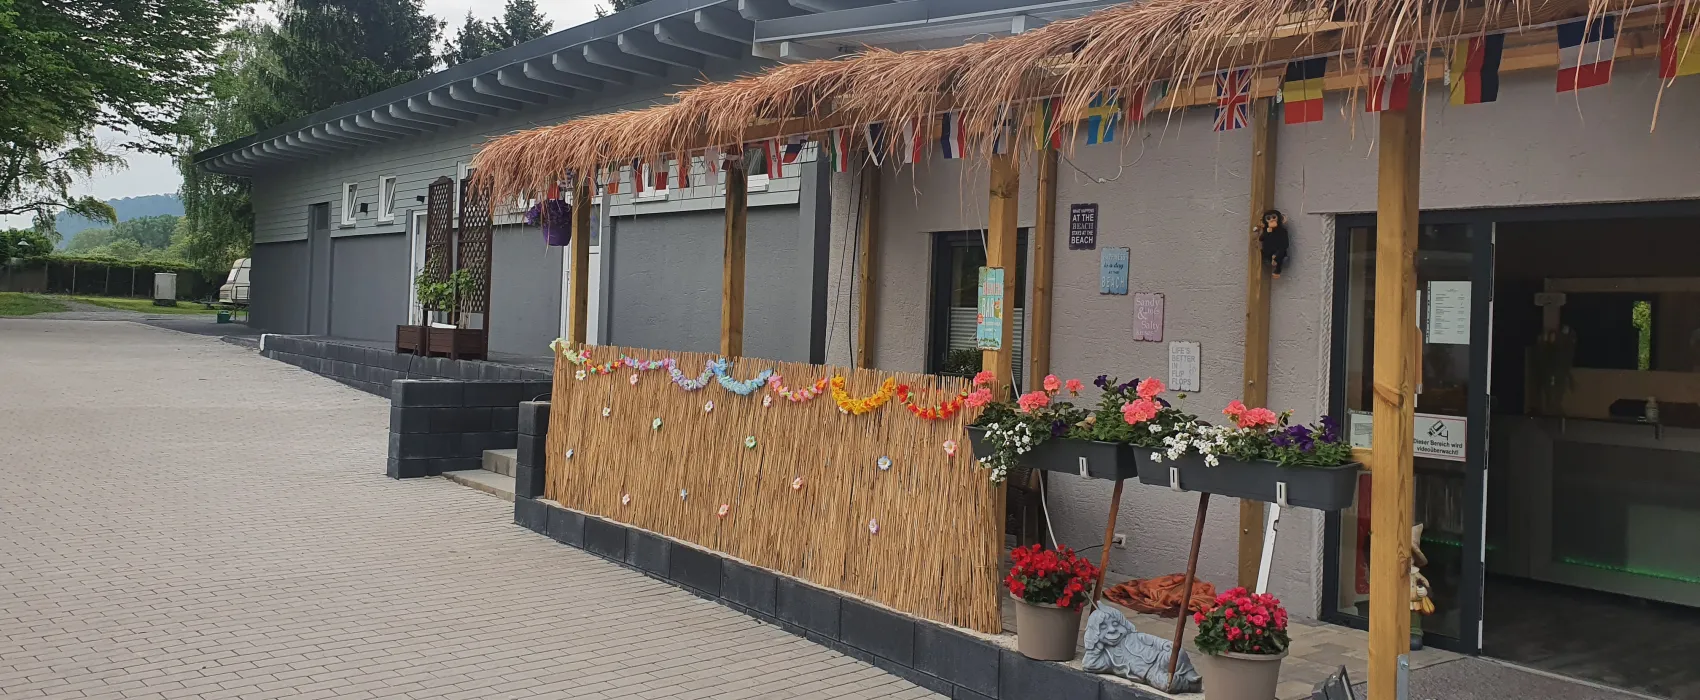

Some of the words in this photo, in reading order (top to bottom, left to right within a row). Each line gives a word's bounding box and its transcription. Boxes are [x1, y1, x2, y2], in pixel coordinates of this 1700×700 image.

[1102, 276, 1124, 288] BEACH
[1136, 298, 1160, 308] Sandy
[1137, 306, 1147, 320] &
[1141, 320, 1160, 332] Salty
